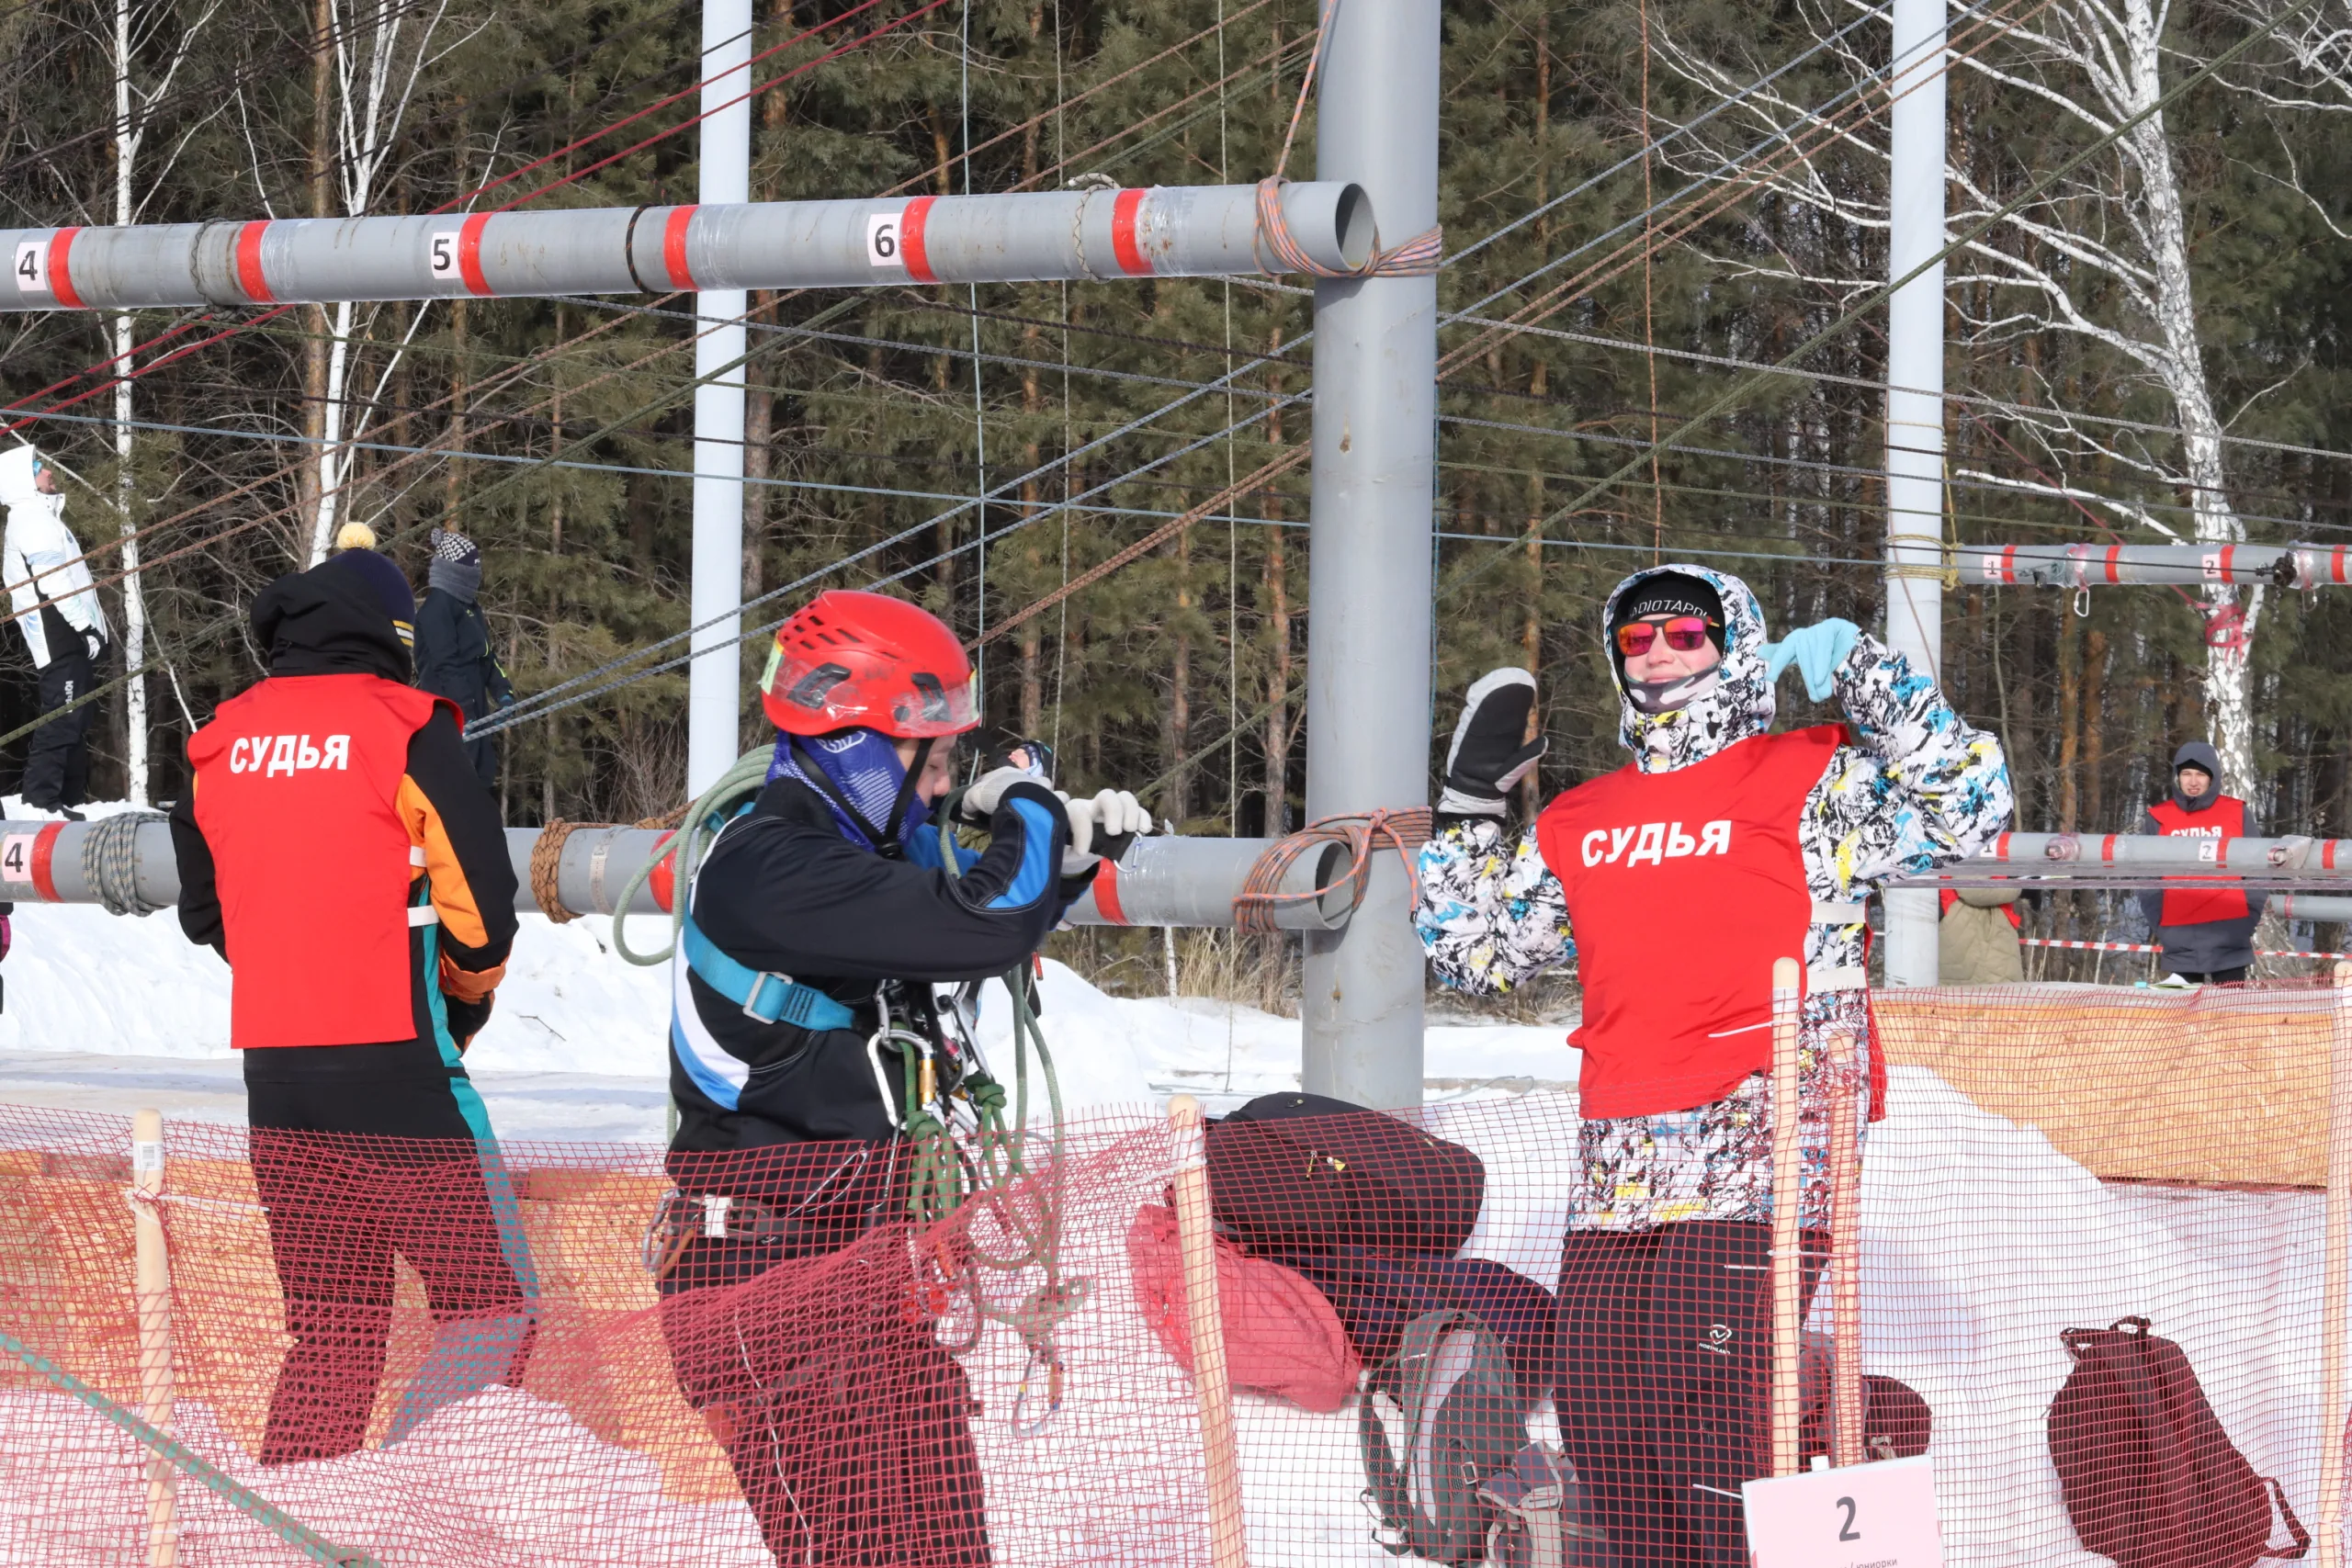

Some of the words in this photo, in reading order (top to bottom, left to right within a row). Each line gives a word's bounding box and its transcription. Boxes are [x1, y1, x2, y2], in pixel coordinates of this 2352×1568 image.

[432, 239, 451, 271] 5
[875, 224, 895, 258] 6
[18, 250, 39, 281] 4
[1988, 560, 1997, 575] 1
[2205, 559, 2216, 574] 2
[230, 734, 351, 778] СУДЬЯ
[4, 842, 24, 874] 4
[1581, 819, 1732, 868] СУДЬЯ
[2202, 845, 2212, 860] 2
[1836, 1496, 1861, 1542] 2
